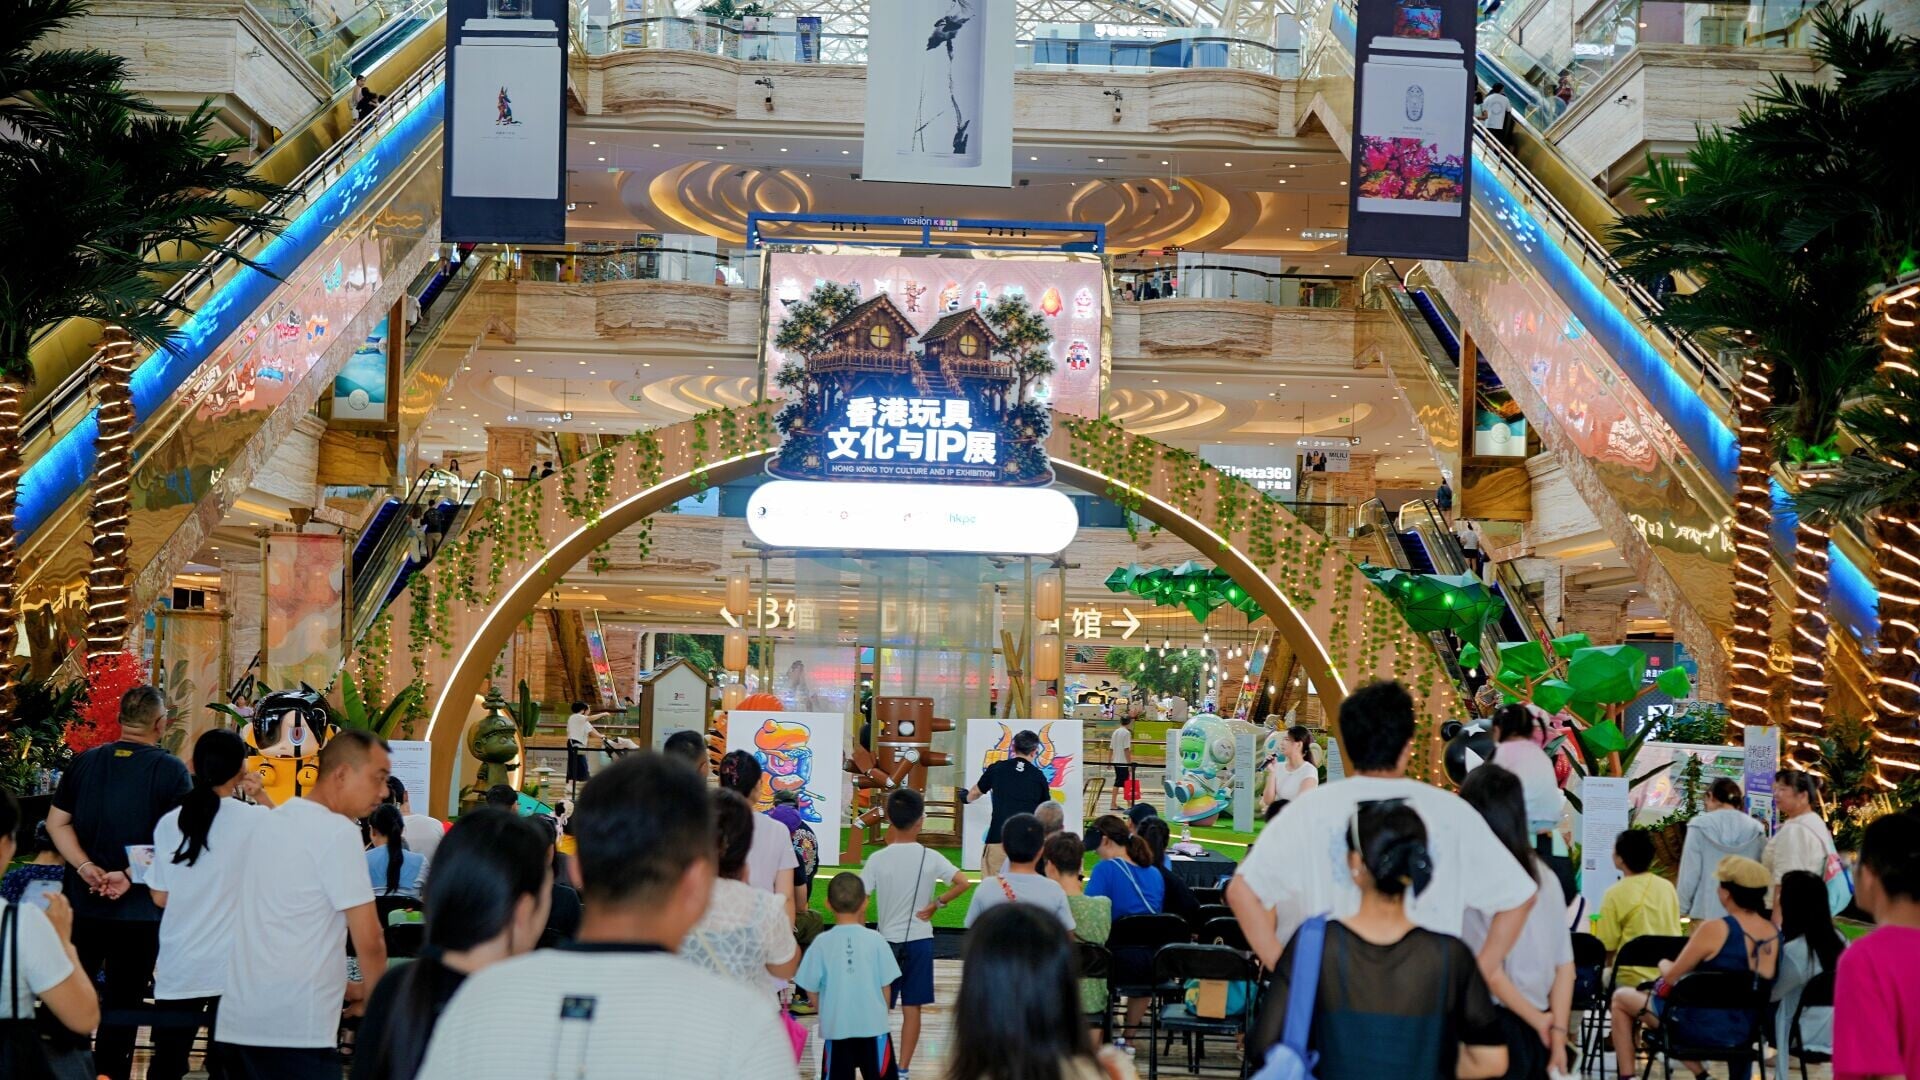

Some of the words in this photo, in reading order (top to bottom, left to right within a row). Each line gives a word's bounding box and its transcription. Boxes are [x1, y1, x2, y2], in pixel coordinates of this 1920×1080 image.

[846, 397, 973, 429] 香港玩具
[827, 427, 997, 464] 文化与IP展
[831, 464, 854, 473] HONG
[856, 465, 878, 474] KONG
[879, 466, 894, 474] TOY
[896, 466, 928, 475] CULTURE
[929, 467, 945, 476] AND
[947, 468, 955, 476] IP
[956, 468, 996, 478] EXHIBITION
[1231, 466, 1292, 480] Insta360
[757, 597, 815, 630] B馆
